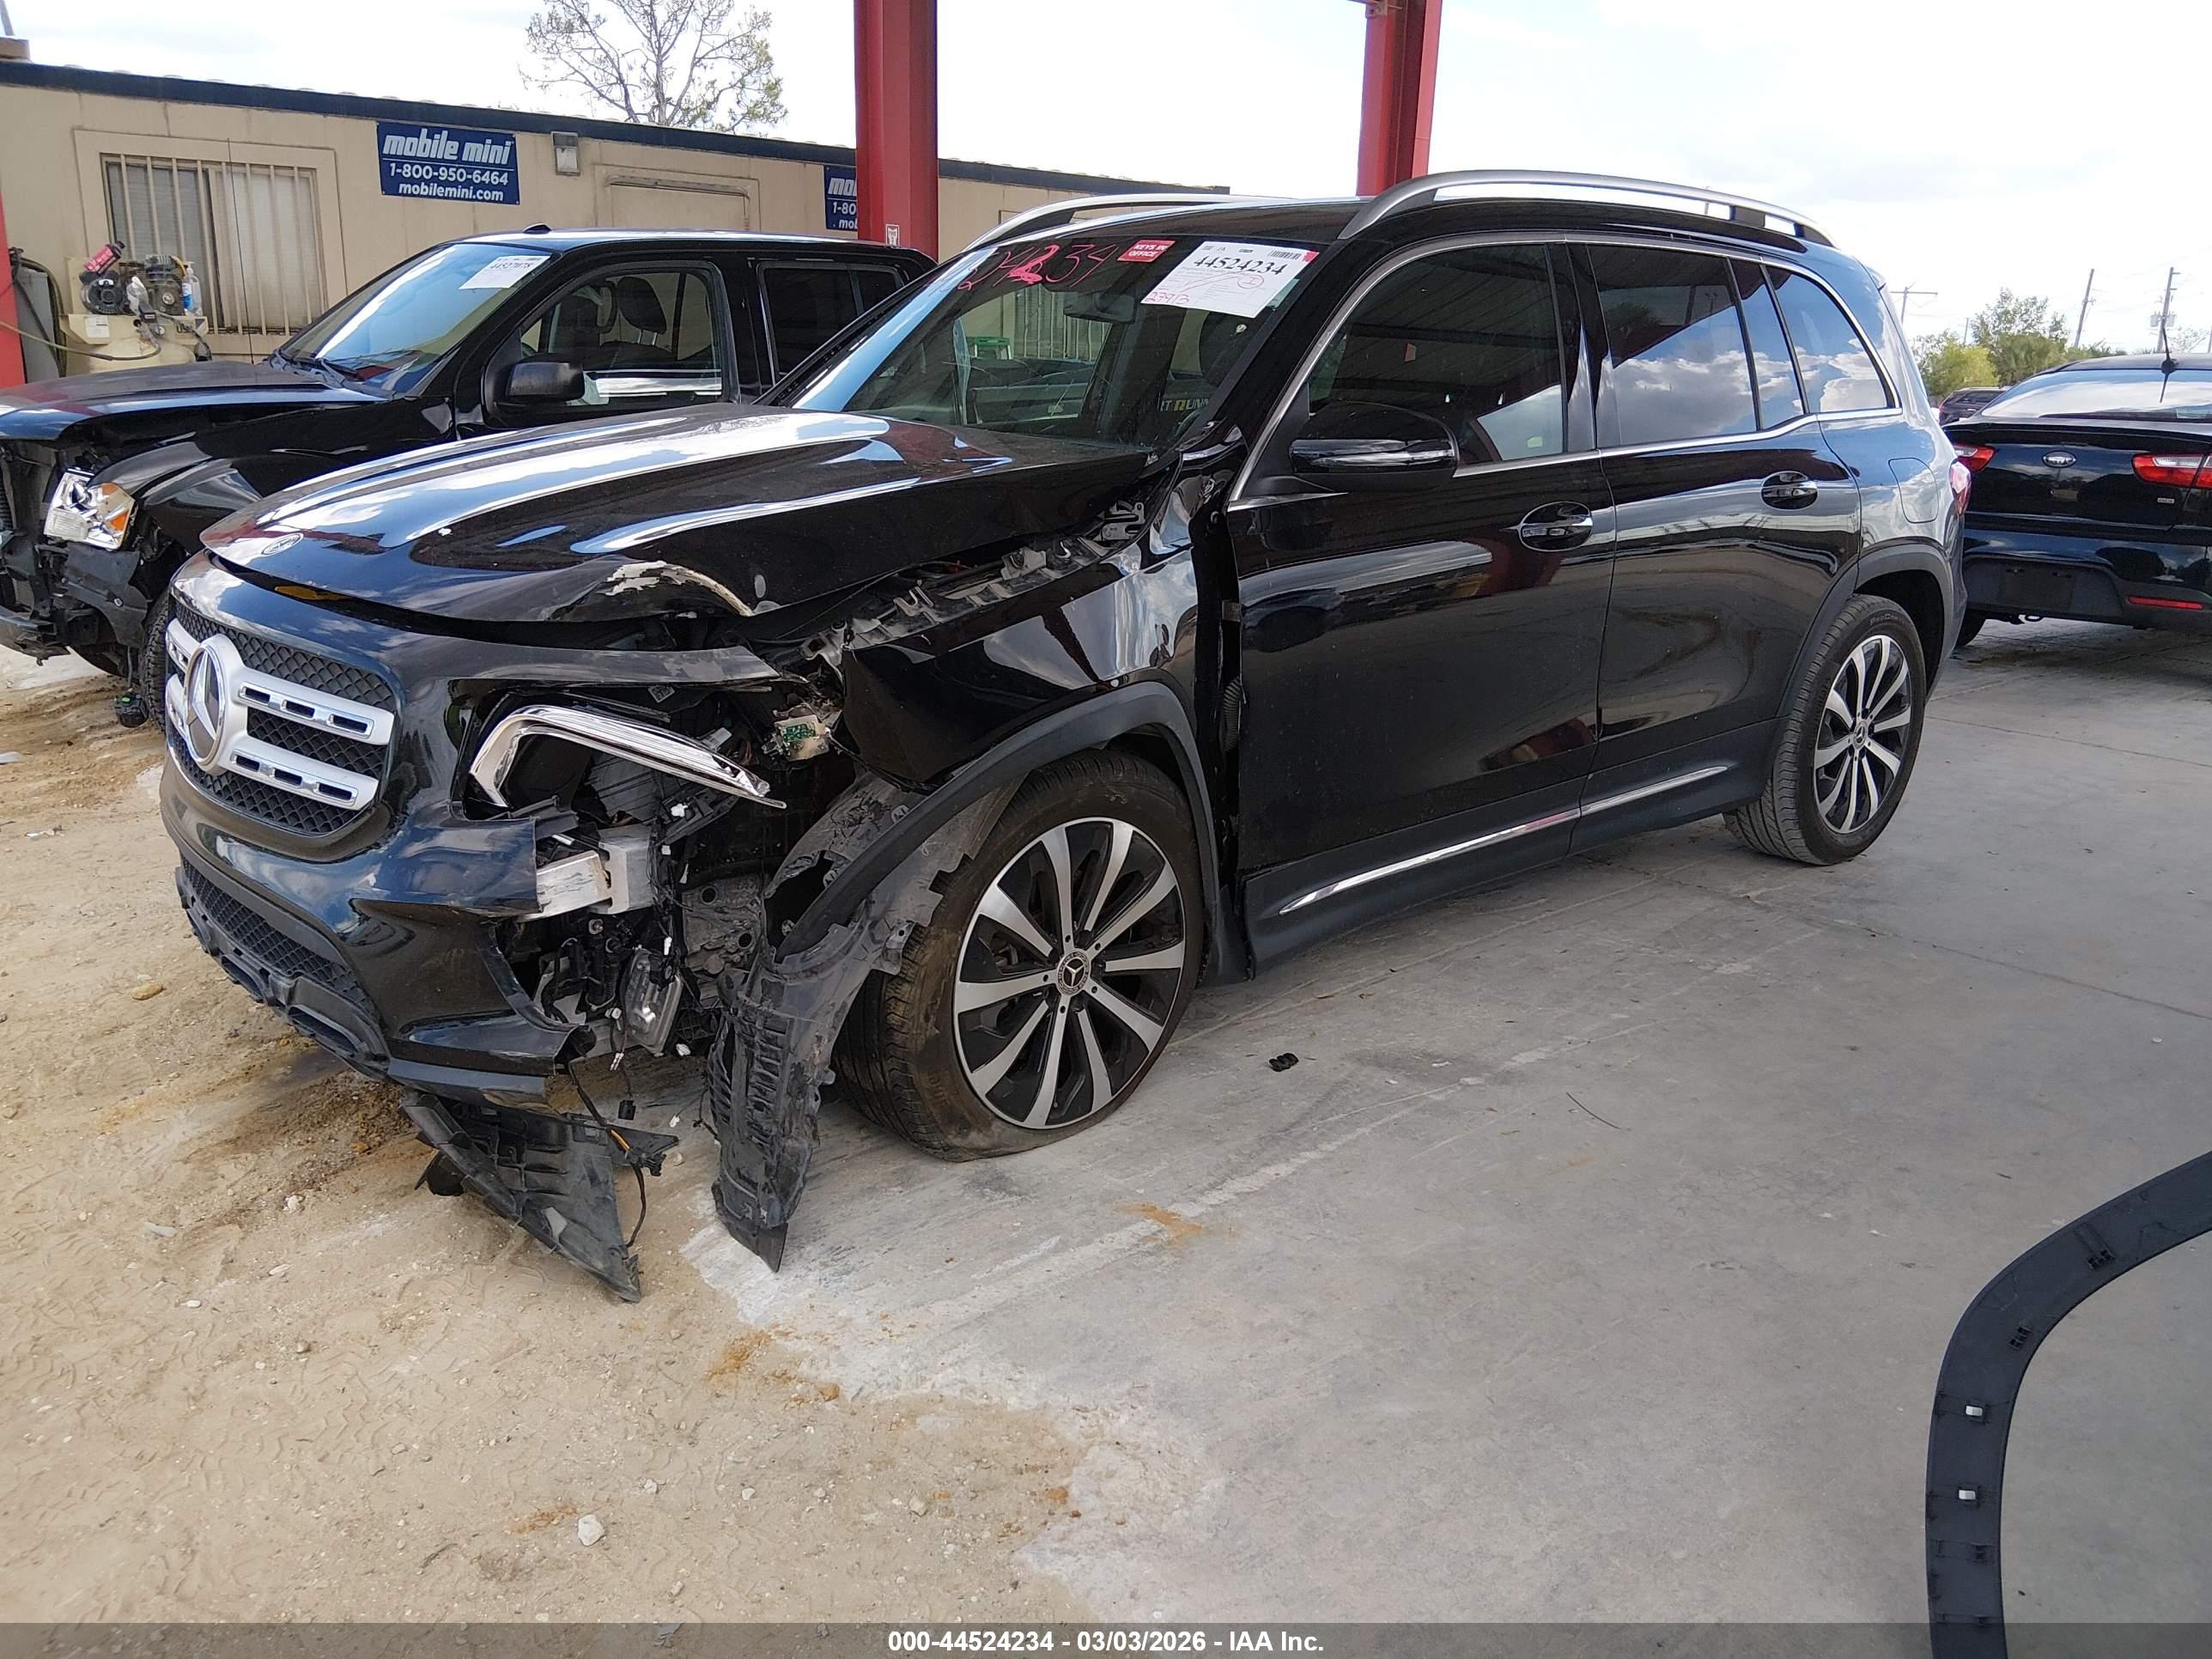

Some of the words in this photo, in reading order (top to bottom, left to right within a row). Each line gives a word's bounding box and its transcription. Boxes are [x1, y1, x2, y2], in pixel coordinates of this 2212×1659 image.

[383, 128, 459, 161] mobile
[462, 138, 512, 165] mini
[390, 162, 508, 185] 1-800-950-6464
[398, 182, 504, 201] mobilemini.com
[1193, 255, 1288, 276] 44524234
